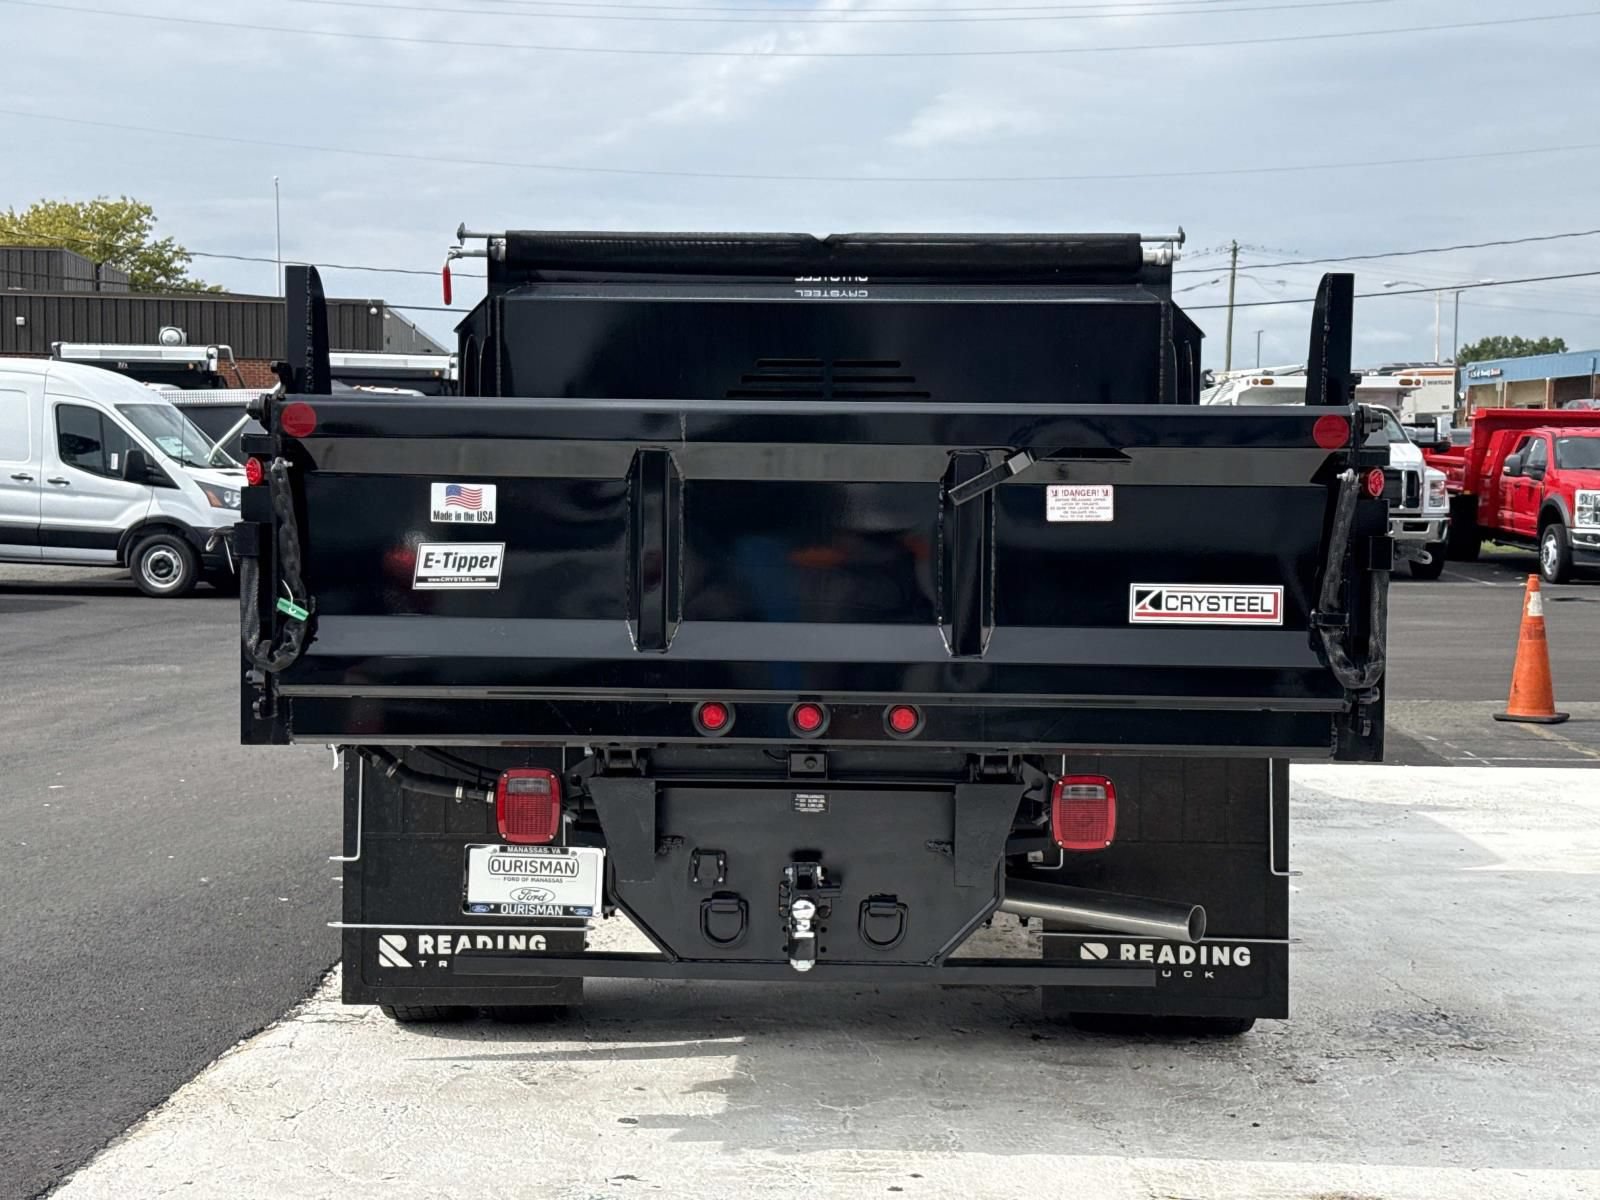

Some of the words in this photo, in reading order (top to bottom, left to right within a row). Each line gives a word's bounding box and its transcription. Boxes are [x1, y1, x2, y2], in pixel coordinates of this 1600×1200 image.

[433, 510, 453, 521] Made
[454, 511, 462, 521] in
[463, 511, 475, 522] the
[476, 510, 494, 522] USA
[423, 552, 498, 573] E-Tipper
[1165, 595, 1273, 613] CRYSTEEL
[551, 847, 561, 855] VA
[490, 859, 576, 874] OURISMAN
[517, 888, 548, 902] Ford
[500, 904, 564, 916] OURISMAN
[418, 934, 547, 954] READING
[1120, 943, 1251, 967] READING
[1161, 970, 1215, 979] UCK
